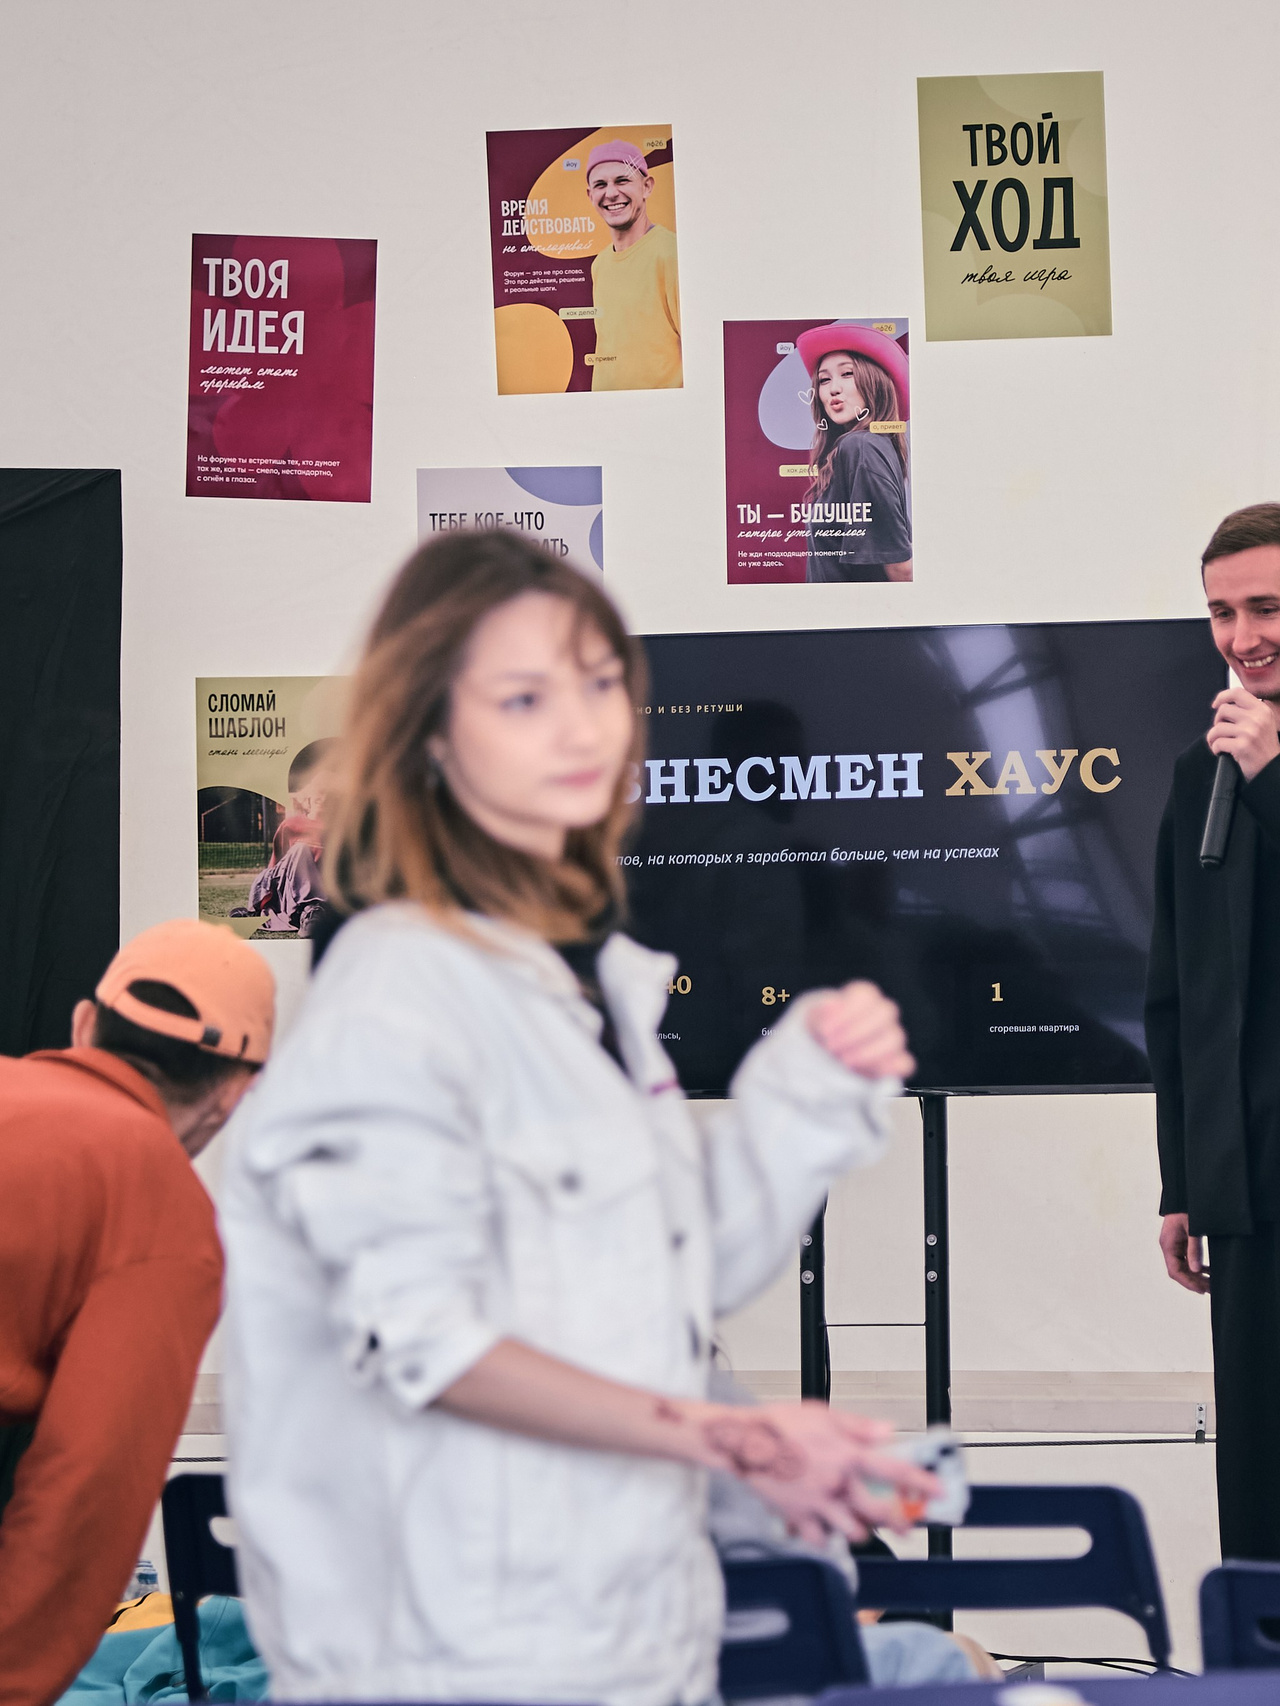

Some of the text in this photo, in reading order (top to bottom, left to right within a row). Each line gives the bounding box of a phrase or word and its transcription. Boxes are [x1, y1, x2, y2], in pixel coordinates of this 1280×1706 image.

[962, 111, 1060, 167] ТВОЙ
[501, 199, 548, 216] ВРЕМЯ
[950, 177, 1081, 253] ХОД
[502, 215, 596, 236] ДЕЙСТВОВАТЬ
[502, 239, 593, 255] не откладывай
[203, 258, 289, 299] ТВОЯ
[503, 270, 525, 278] Форум
[529, 277, 558, 285] действия,
[961, 264, 1072, 290] твоя игра
[203, 309, 304, 355] ИДЕЯ
[200, 365, 298, 377] может стать
[200, 376, 265, 393] прорывом
[209, 455, 237, 466] форуме
[248, 458, 286, 467] встретишь
[287, 459, 300, 467] тех,
[314, 460, 340, 468] думает
[256, 468, 280, 476] смело,
[282, 468, 333, 477] нестандартно,
[429, 512, 468, 532] ТЕБЕ
[737, 503, 760, 524] ТЫ
[790, 502, 873, 525] БУДУЩЕЕ
[737, 528, 867, 543] которое уже началось
[762, 560, 784, 568] здесь.
[764, 551, 813, 559] «подходящего
[208, 689, 276, 713] СЛОМАЙ
[658, 706, 665, 715] И
[671, 705, 691, 714] БЕЗ
[696, 703, 744, 714] РЕТУШИ
[208, 717, 286, 739] ШАБЛОН
[208, 748, 239, 756] стань
[945, 747, 1122, 797] ХАУС
[615, 847, 1000, 868] пов, на которых я заработал больше, чем на успехах
[761, 986, 791, 1006] 8+
[991, 982, 1004, 1002] 1
[989, 1023, 1080, 1034] сгоревшая квартира
